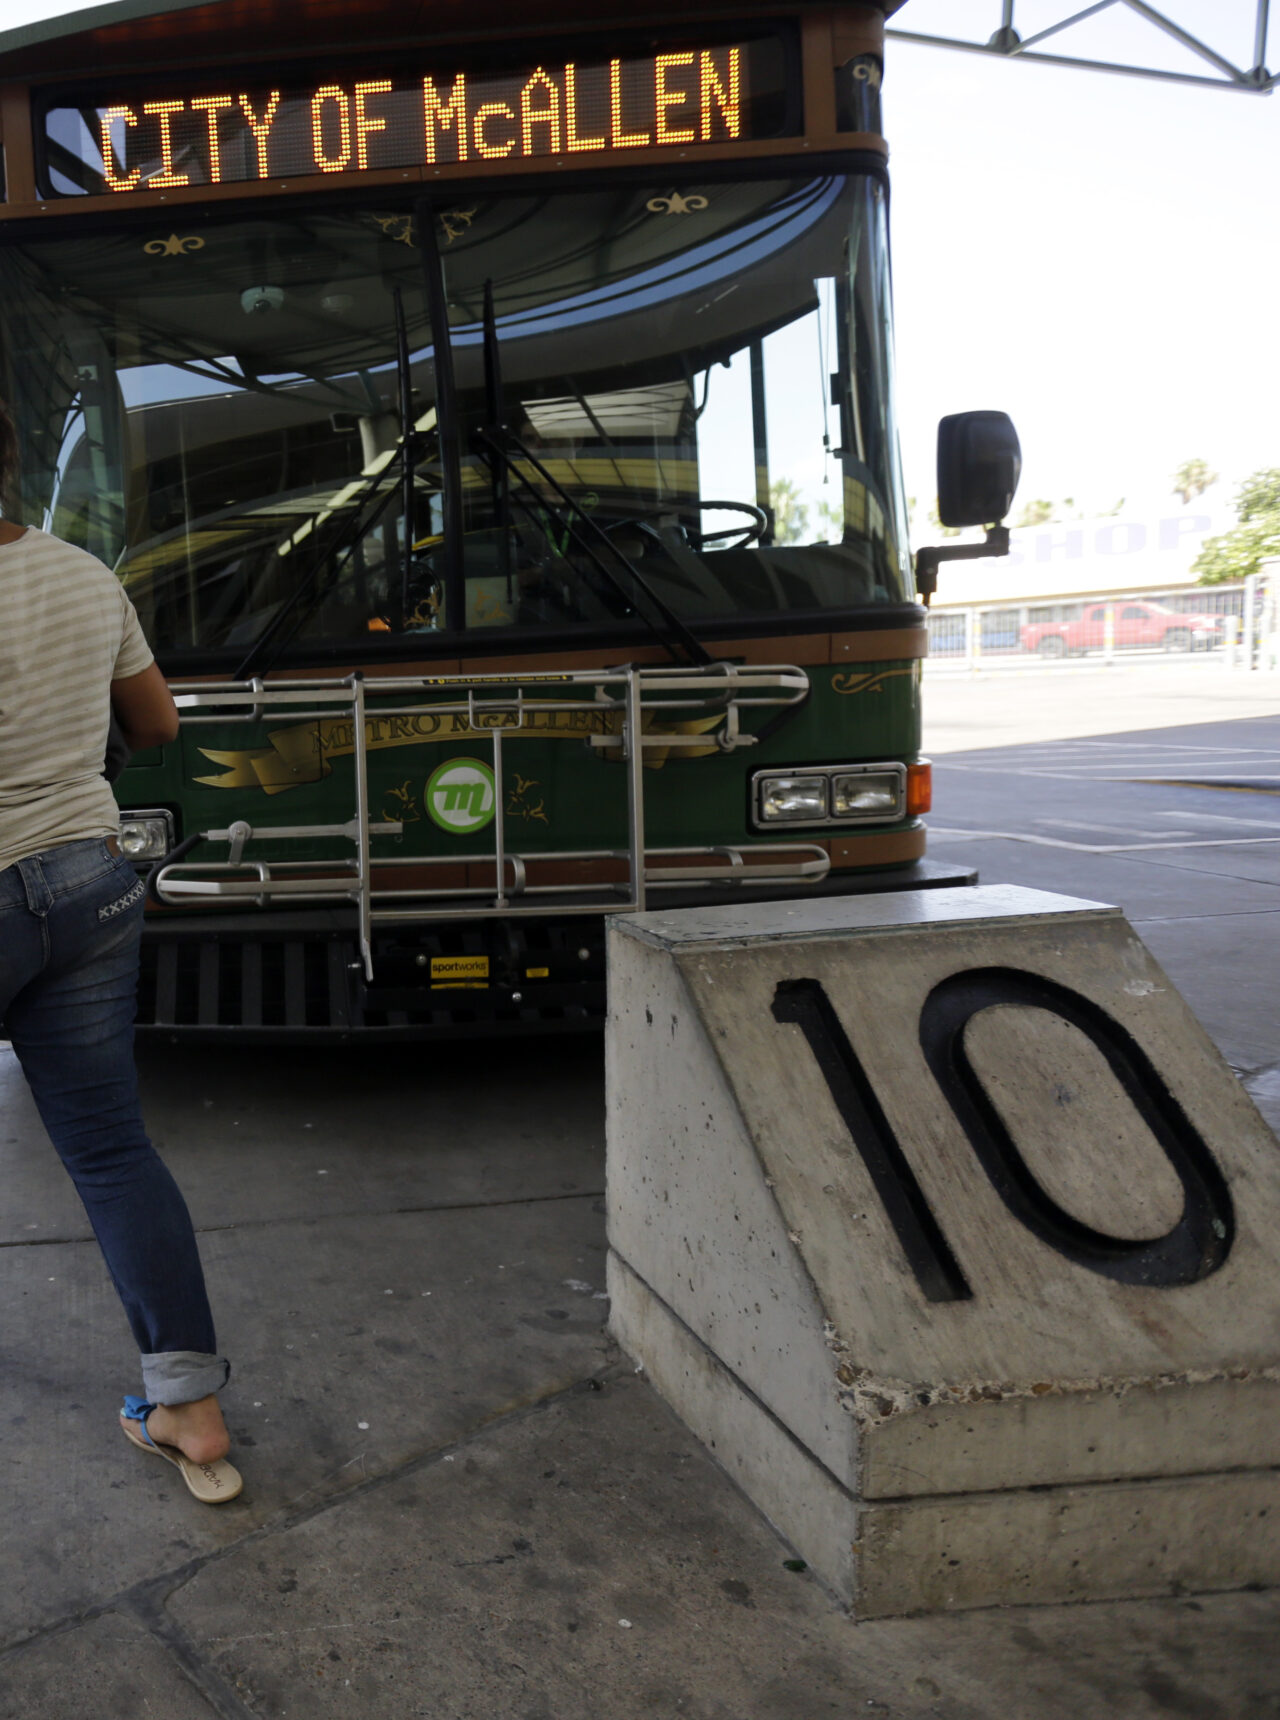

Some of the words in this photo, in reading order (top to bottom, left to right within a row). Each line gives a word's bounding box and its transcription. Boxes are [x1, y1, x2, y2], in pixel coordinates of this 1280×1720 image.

[100, 91, 280, 191] CITY
[311, 80, 393, 173] OF
[423, 48, 741, 164] McALLEN
[432, 961, 487, 974] sportworks
[770, 965, 1236, 1302] 10
